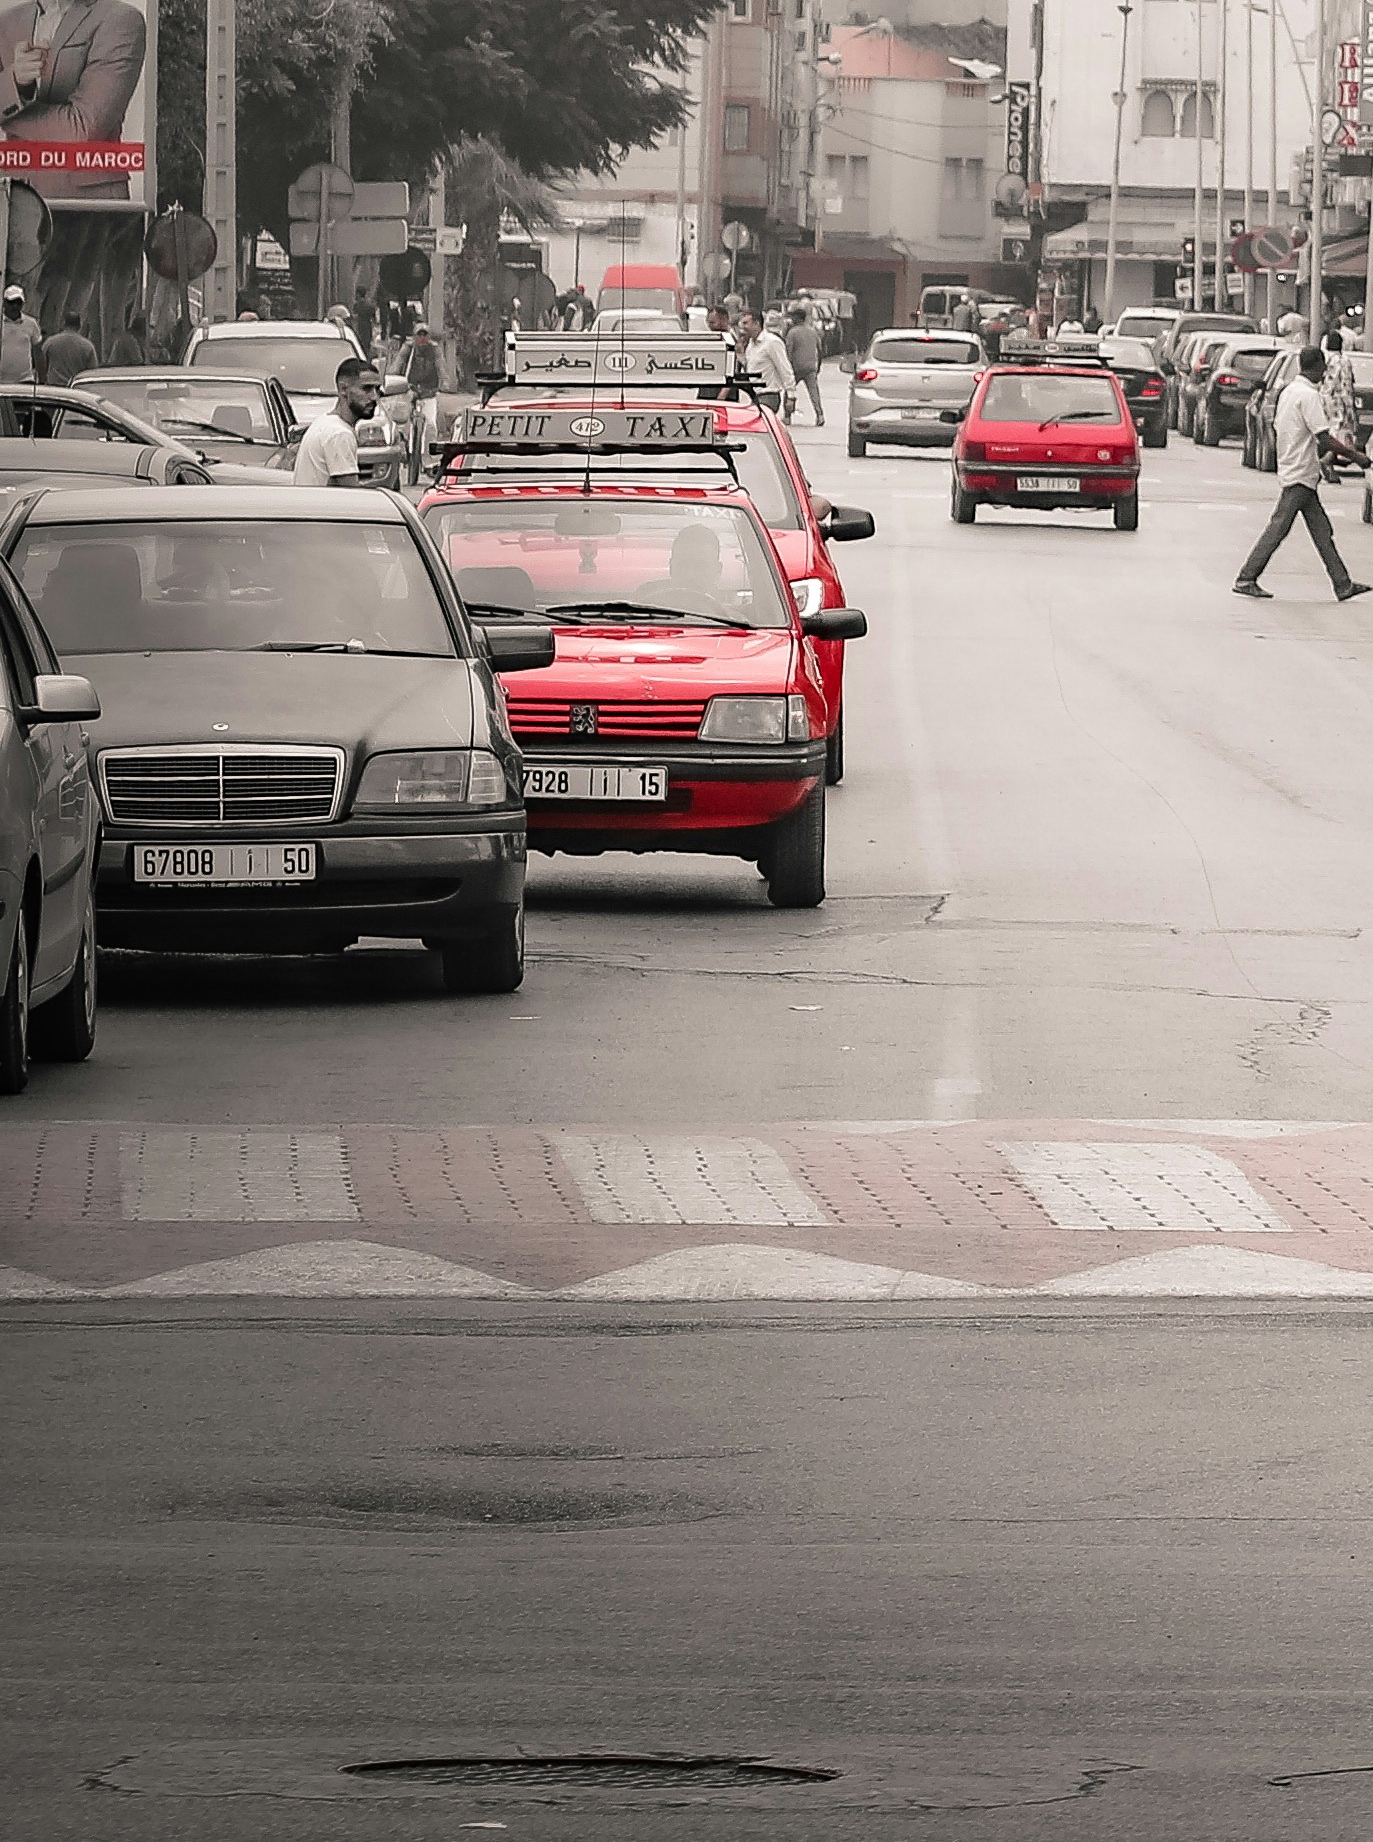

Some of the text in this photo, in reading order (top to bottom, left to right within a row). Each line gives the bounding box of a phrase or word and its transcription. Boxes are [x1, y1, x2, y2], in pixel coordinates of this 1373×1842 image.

[1337, 43, 1361, 147] REX
[1008, 84, 1029, 174] Pionee
[41, 151, 66, 167] DU
[75, 152, 143, 168] MAROC
[522, 353, 715, 374] طاكسي 111 صغير
[469, 415, 711, 438] PETIT 412 TAXI
[690, 506, 736, 519] TAXI
[522, 770, 568, 794] 7928
[639, 772, 660, 796] 15
[143, 849, 214, 876] 67808
[283, 847, 310, 875] 50
